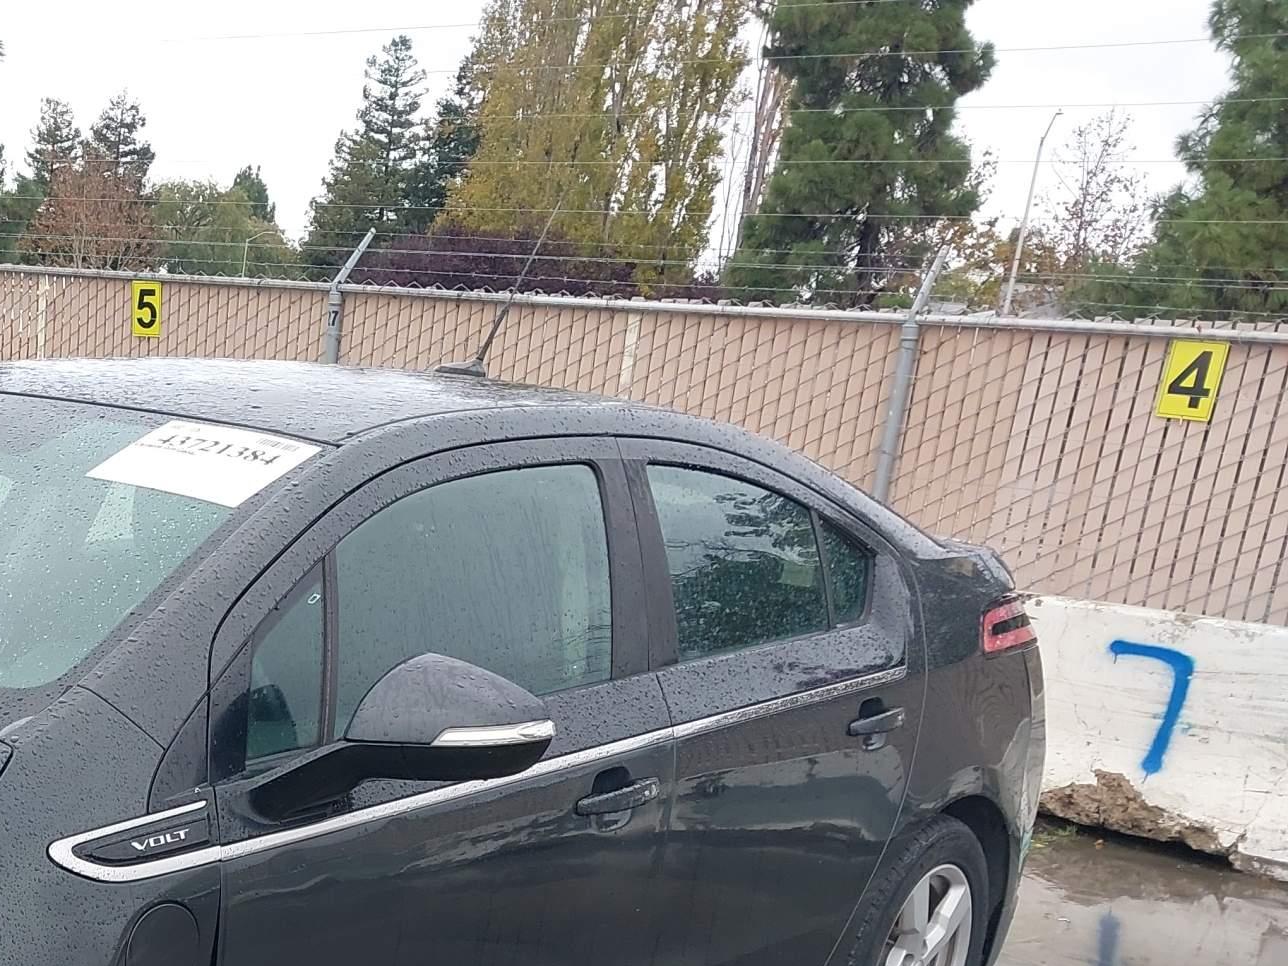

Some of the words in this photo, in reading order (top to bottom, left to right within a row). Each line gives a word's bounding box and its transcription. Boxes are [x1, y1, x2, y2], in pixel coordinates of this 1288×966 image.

[137, 288, 157, 329] 5
[1167, 350, 1214, 409] 4
[158, 434, 281, 466] 43721384
[1109, 639, 1195, 780] 7
[131, 829, 190, 851] VOLT
